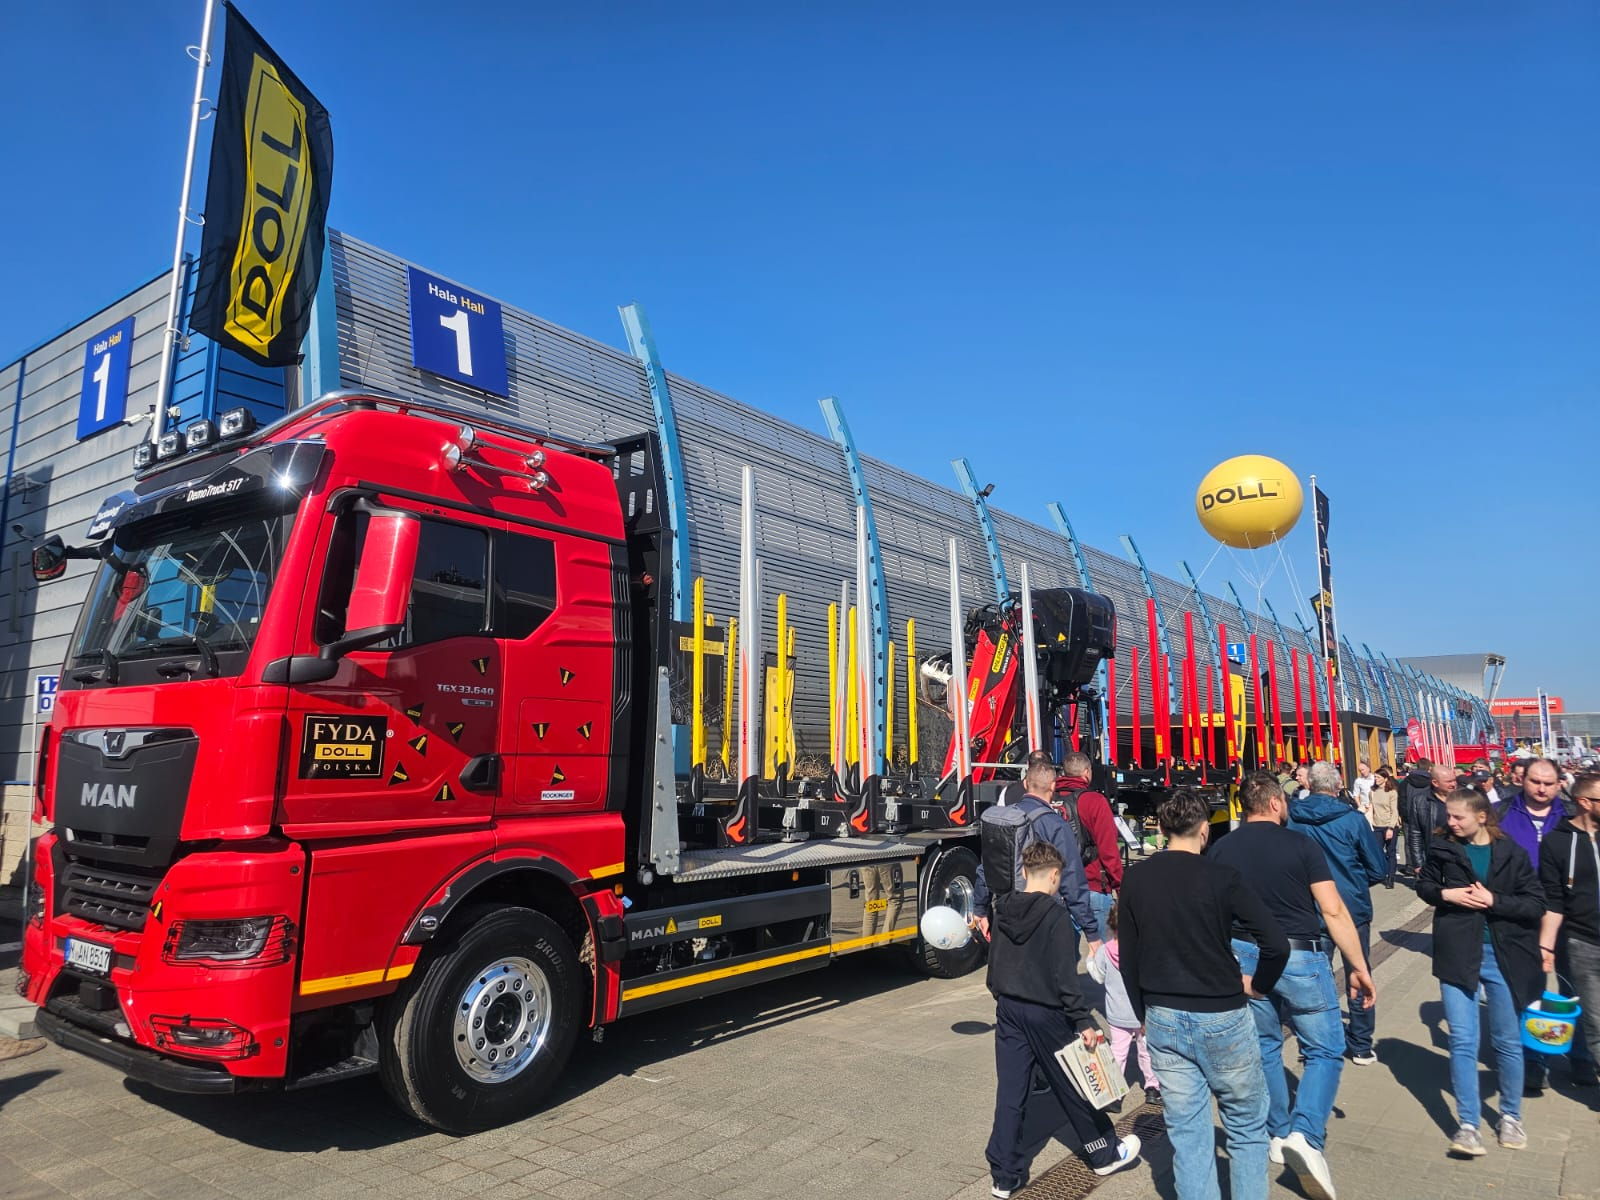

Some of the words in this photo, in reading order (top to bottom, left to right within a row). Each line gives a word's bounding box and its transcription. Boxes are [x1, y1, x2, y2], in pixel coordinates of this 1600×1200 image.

[241, 123, 301, 321] DOLL
[428, 282, 458, 304] Hala
[461, 296, 485, 315] Hall
[93, 340, 108, 356] Hala
[108, 330, 122, 348] Hall
[440, 309, 473, 376] 1
[93, 353, 111, 421] 1
[186, 482, 227, 502] DemoTruck
[226, 478, 243, 491] 517
[1202, 482, 1278, 511] DOLL
[1231, 644, 1238, 656] 1
[436, 683, 458, 693] TGX
[459, 686, 495, 696] 33.640
[313, 723, 377, 741] FYDA
[322, 747, 365, 757] DOLL
[312, 763, 371, 771] POLSKA
[80, 782, 138, 808] MAN
[631, 926, 665, 941] MAN
[701, 917, 720, 927] DOLL
[1085, 1065, 1101, 1096] WRP
